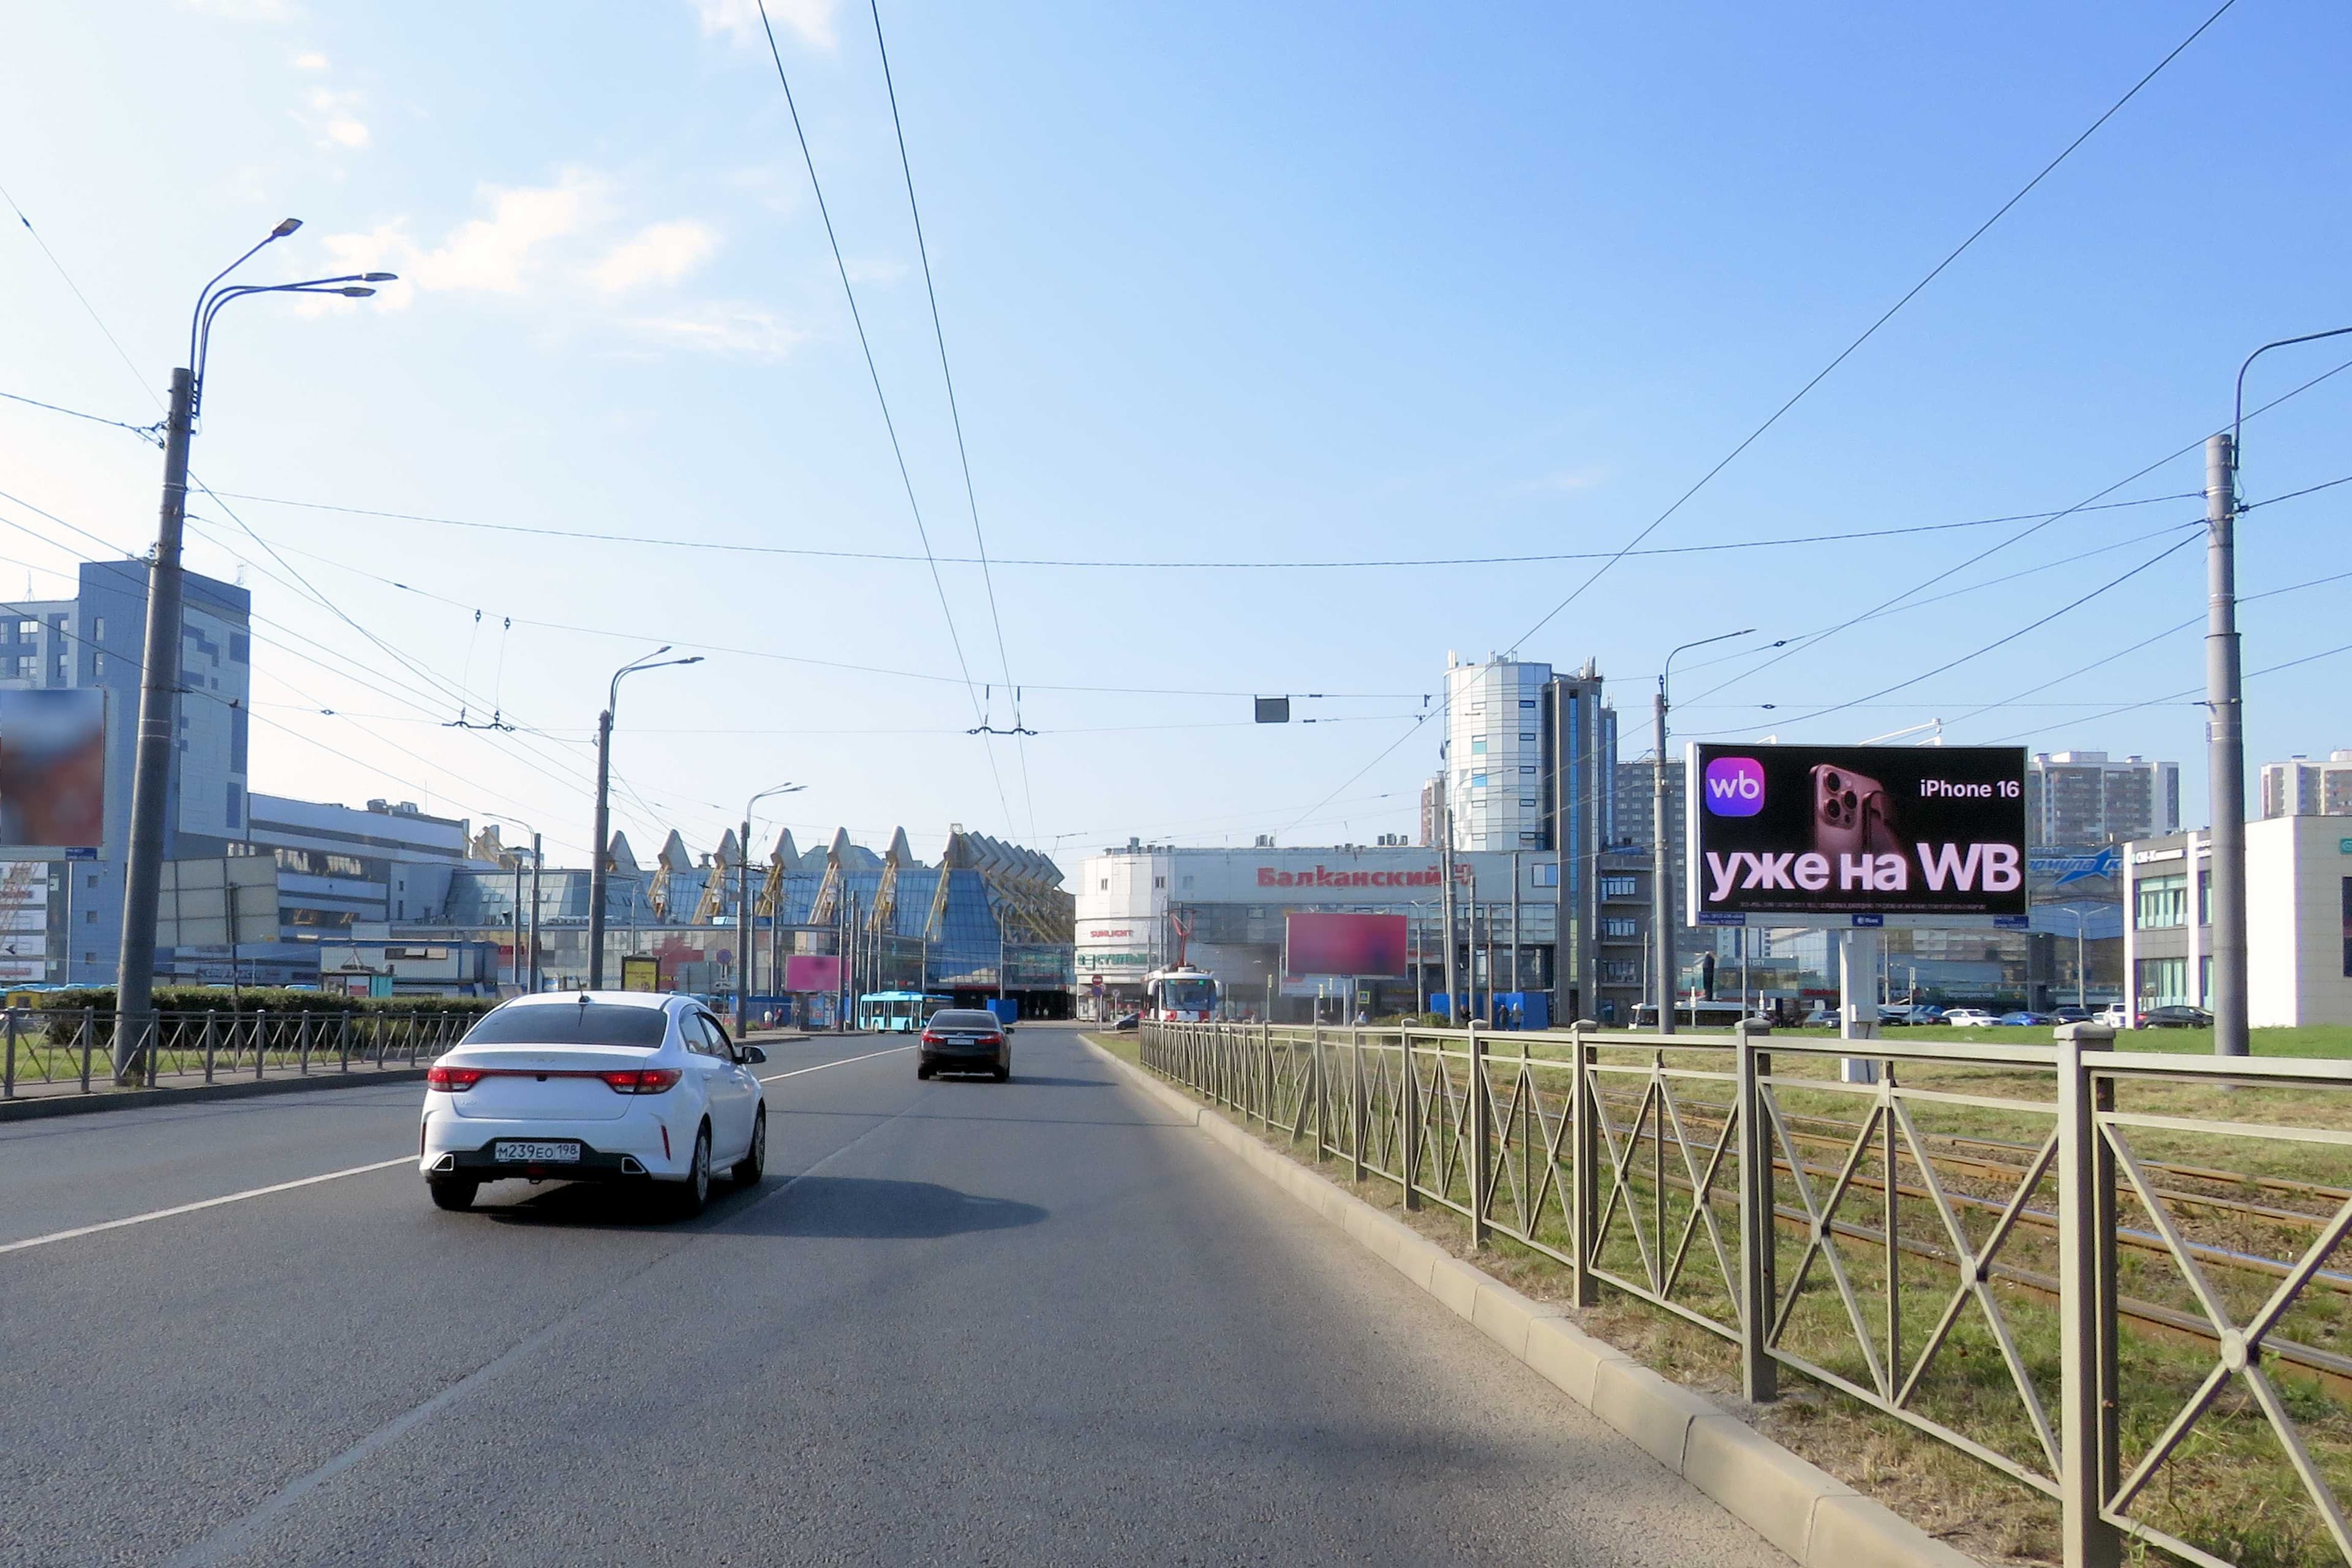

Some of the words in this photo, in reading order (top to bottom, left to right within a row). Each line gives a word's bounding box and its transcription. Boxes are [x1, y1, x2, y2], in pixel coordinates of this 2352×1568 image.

[1709, 770, 1760, 799] wb
[1920, 779, 1992, 797] iPhone
[1996, 780, 2020, 797] 16
[1257, 865, 1442, 887] Балканский
[1706, 851, 1830, 902] уже
[1840, 853, 1907, 891] на
[1917, 843, 2021, 892] WB
